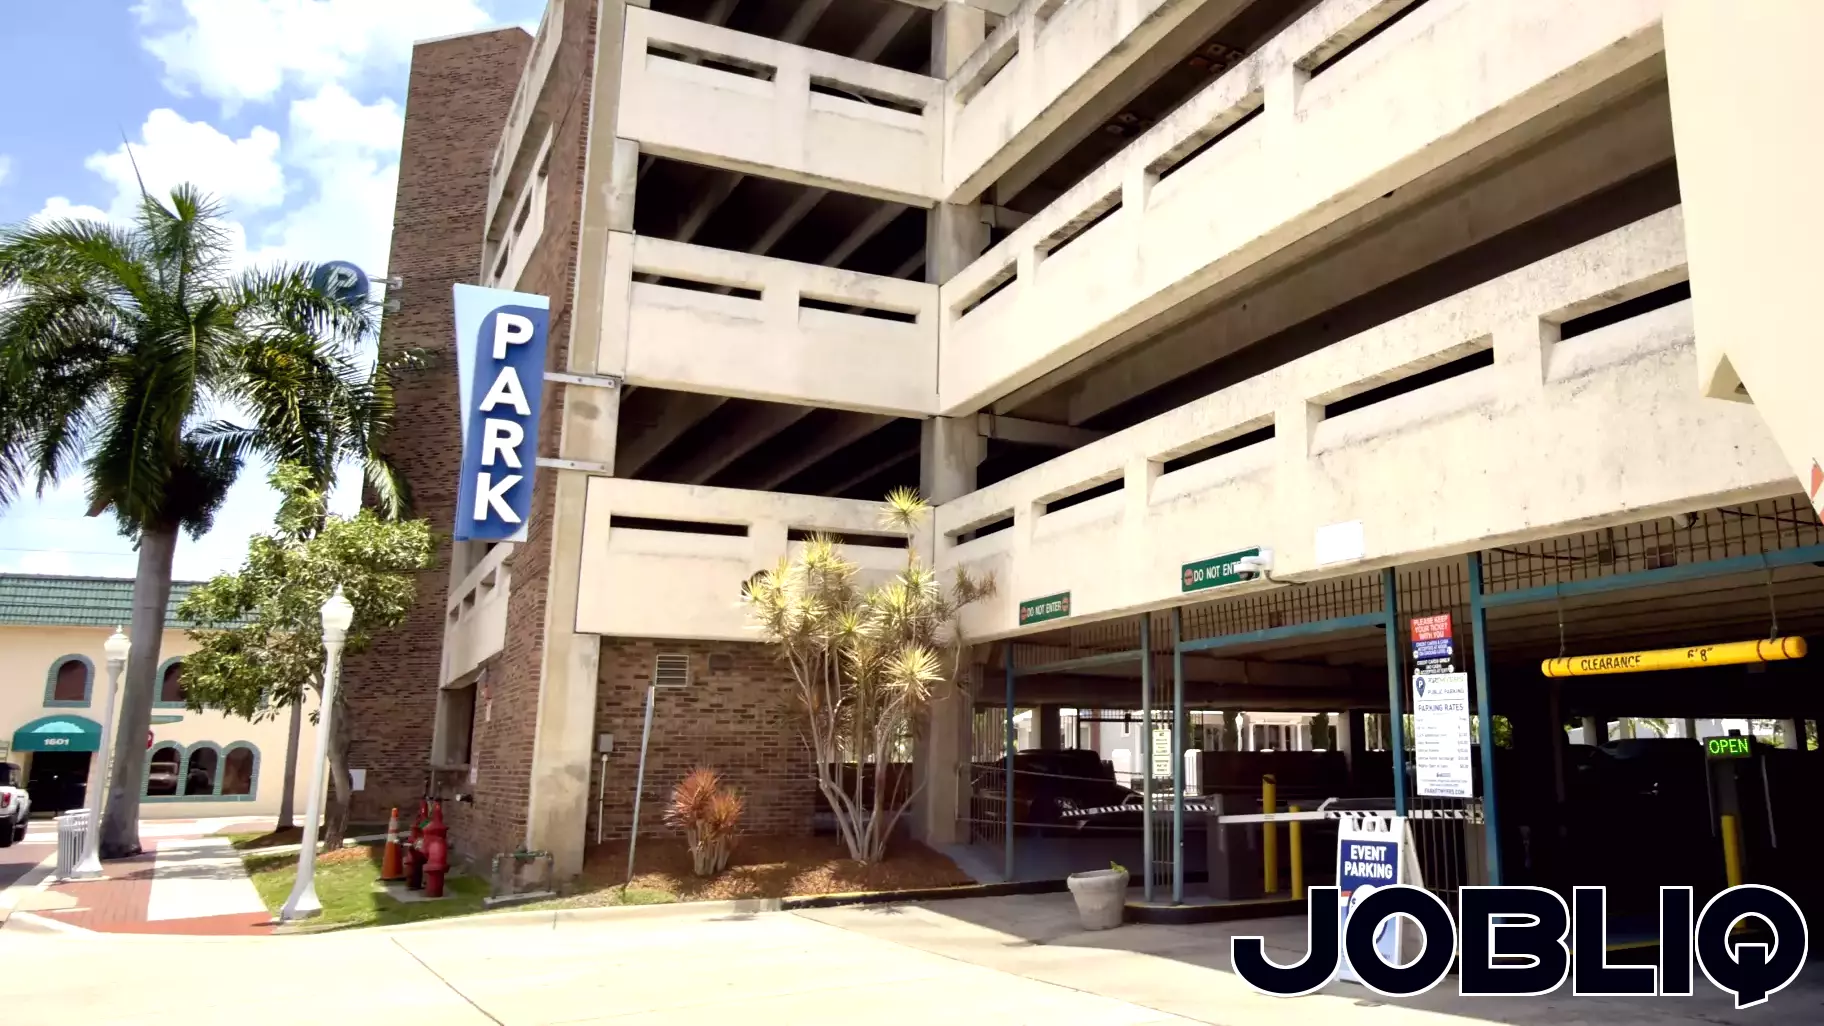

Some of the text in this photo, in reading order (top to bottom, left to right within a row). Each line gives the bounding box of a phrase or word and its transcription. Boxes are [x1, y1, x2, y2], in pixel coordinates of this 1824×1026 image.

[327, 265, 359, 296] P
[473, 312, 534, 524] PARK
[1194, 561, 1242, 582] DO NOT ENT
[1027, 600, 1062, 617] DO NOT ENTER
[1414, 614, 1448, 626] PLEASE KEEP
[1414, 622, 1448, 634] YOUR TICKET
[1433, 630, 1444, 638] YOU
[1581, 655, 1641, 671] CLEARANCE
[1709, 738, 1748, 754] OPEN
[1350, 845, 1387, 862] EVENT
[1344, 861, 1393, 879] PARKING
